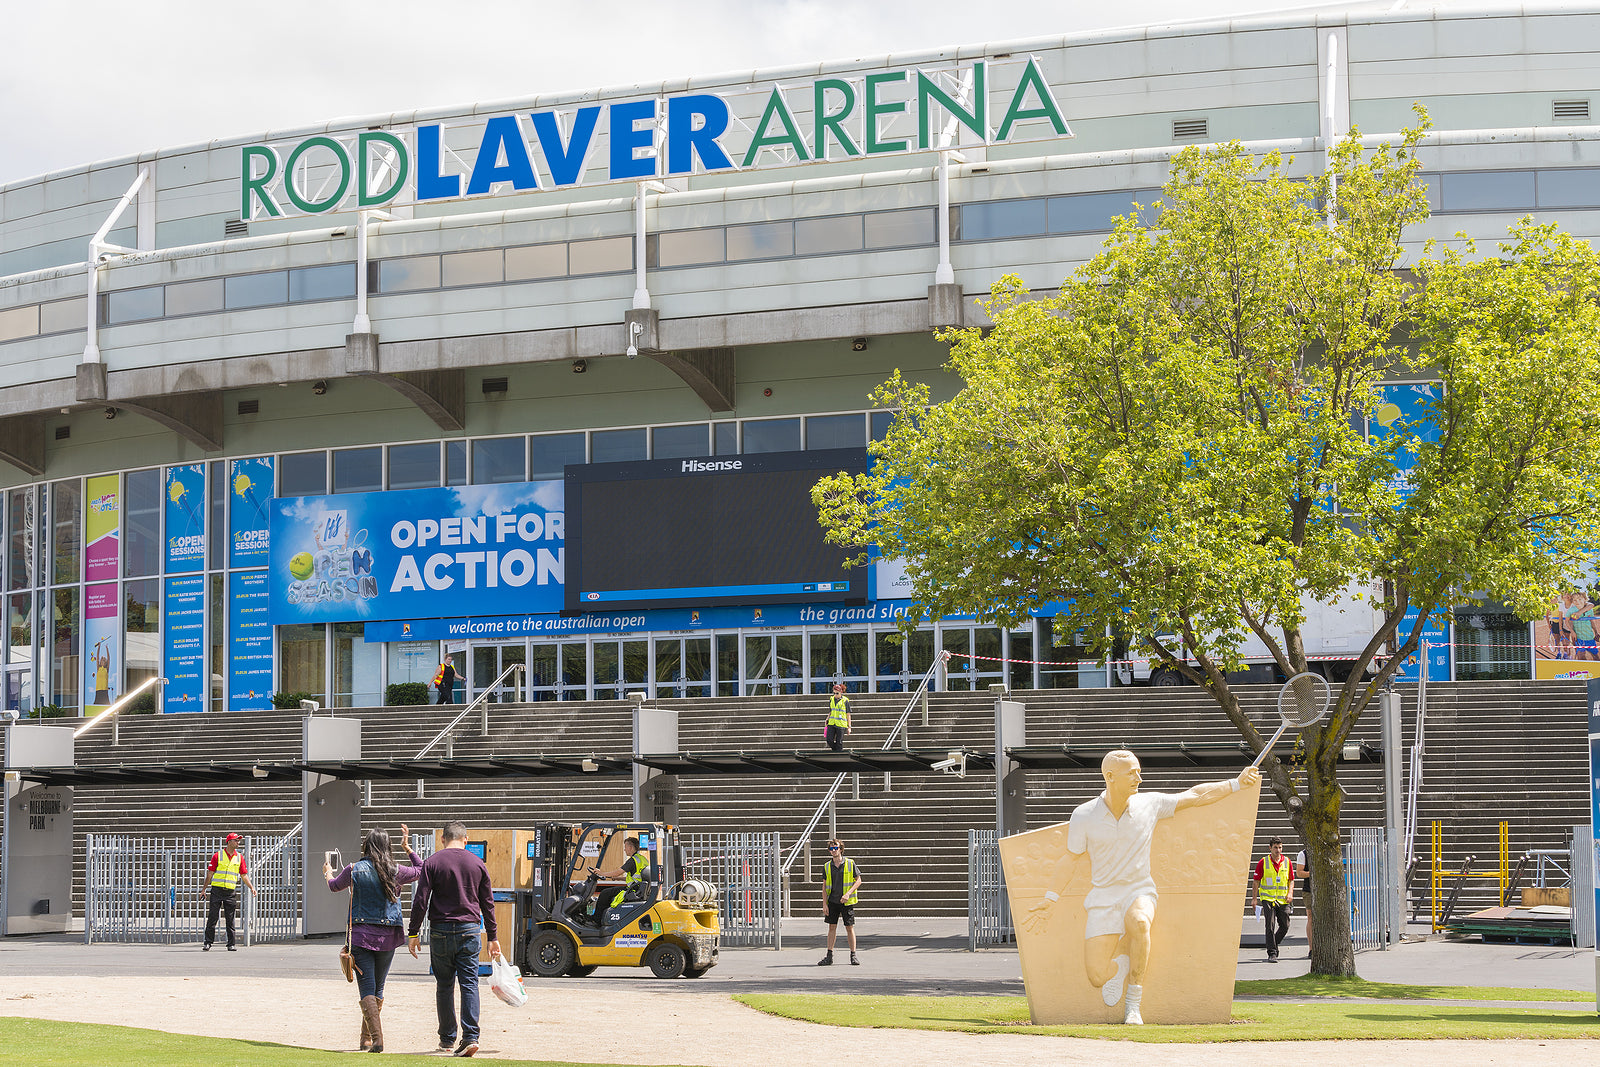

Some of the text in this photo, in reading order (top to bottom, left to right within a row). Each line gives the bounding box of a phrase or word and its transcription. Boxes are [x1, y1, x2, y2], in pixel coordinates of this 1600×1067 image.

[241, 56, 1073, 221] ROD LAVER ARENA
[681, 460, 743, 473] Hisense
[390, 512, 565, 549] OPEN FOR
[170, 546, 204, 556] SESSIONS
[177, 535, 204, 547] OPEN
[389, 547, 565, 593] ACTION
[287, 576, 378, 605] SEASON
[449, 613, 646, 634] welcome to the australian open
[800, 605, 825, 622] the
[829, 604, 877, 624] grand
[30, 800, 61, 814] MELBOURNE
[30, 816, 46, 830] PARK
